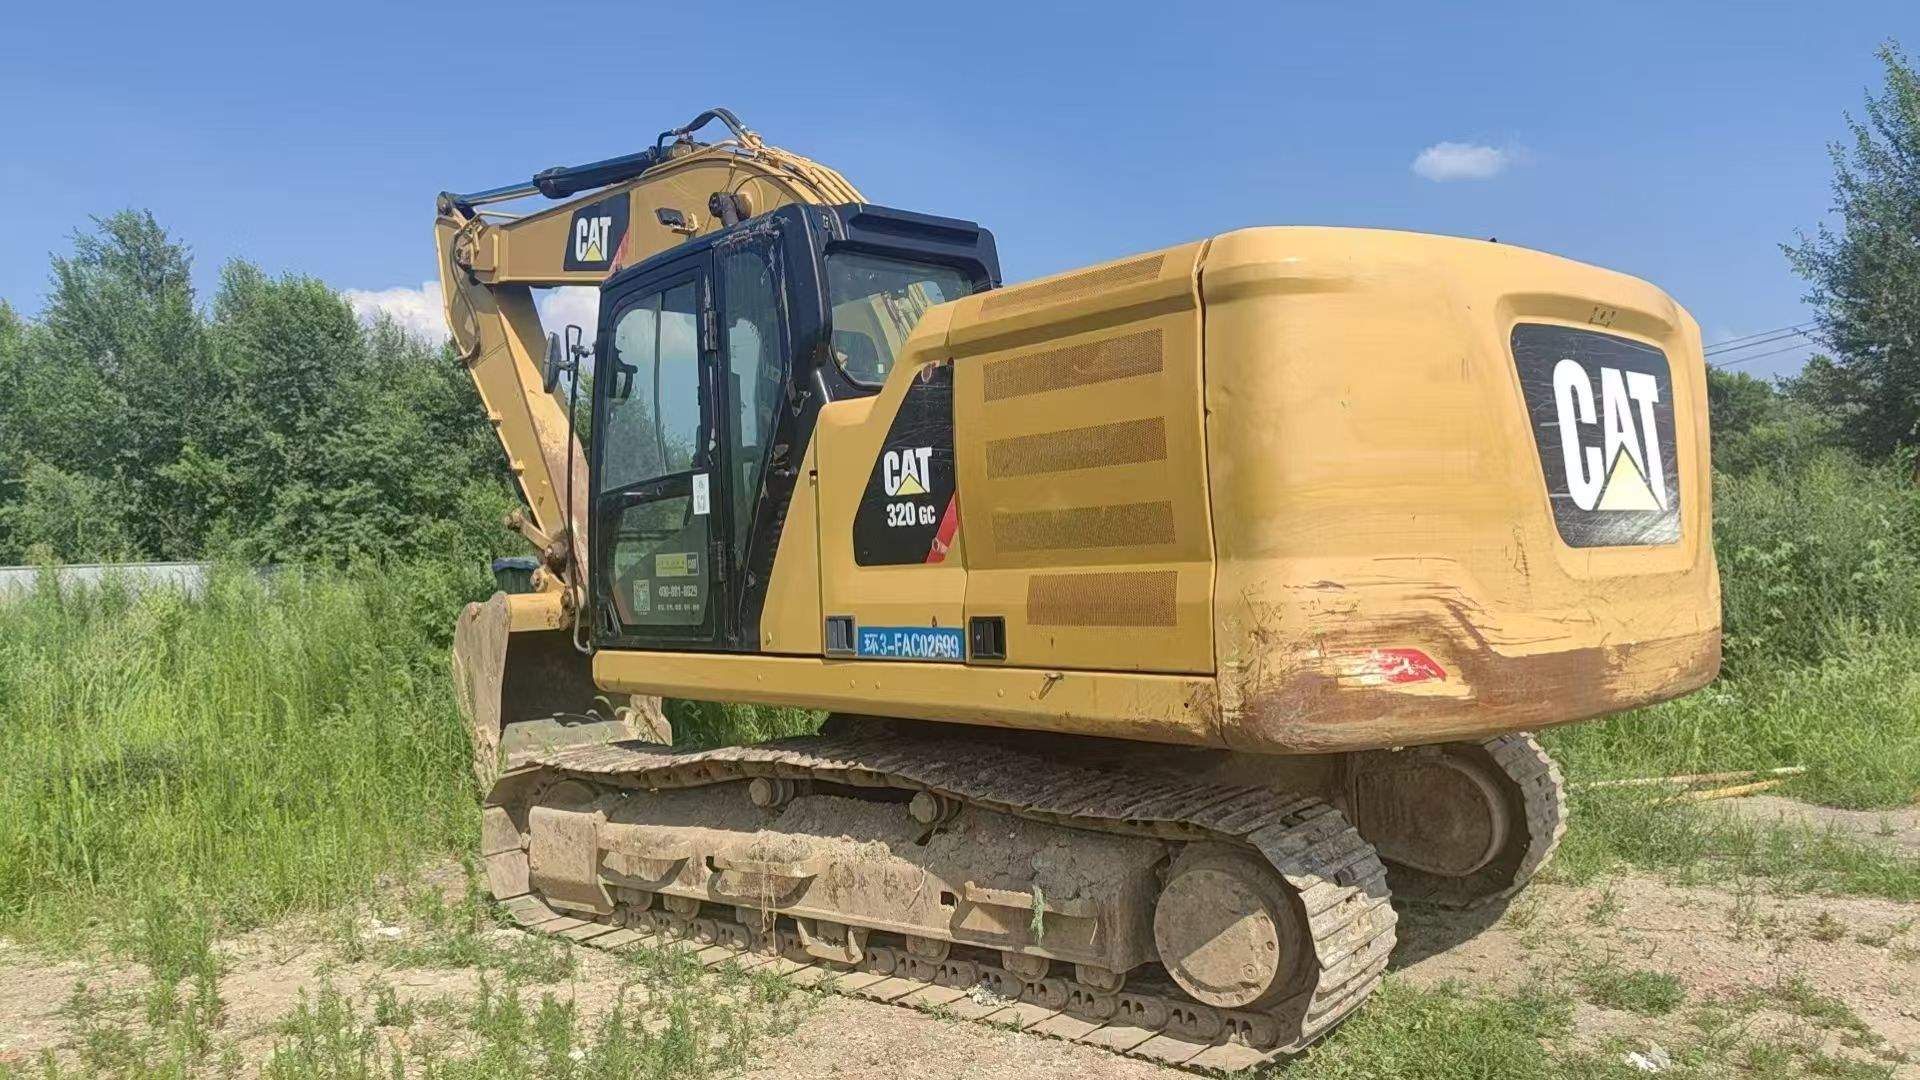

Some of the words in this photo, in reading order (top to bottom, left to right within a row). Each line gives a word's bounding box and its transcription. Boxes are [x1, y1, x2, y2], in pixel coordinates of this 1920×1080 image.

[575, 216, 612, 262] CAT
[1553, 359, 1668, 511] CAT
[883, 447, 932, 496] CAT
[886, 502, 916, 527] 320
[918, 505, 936, 525] GC
